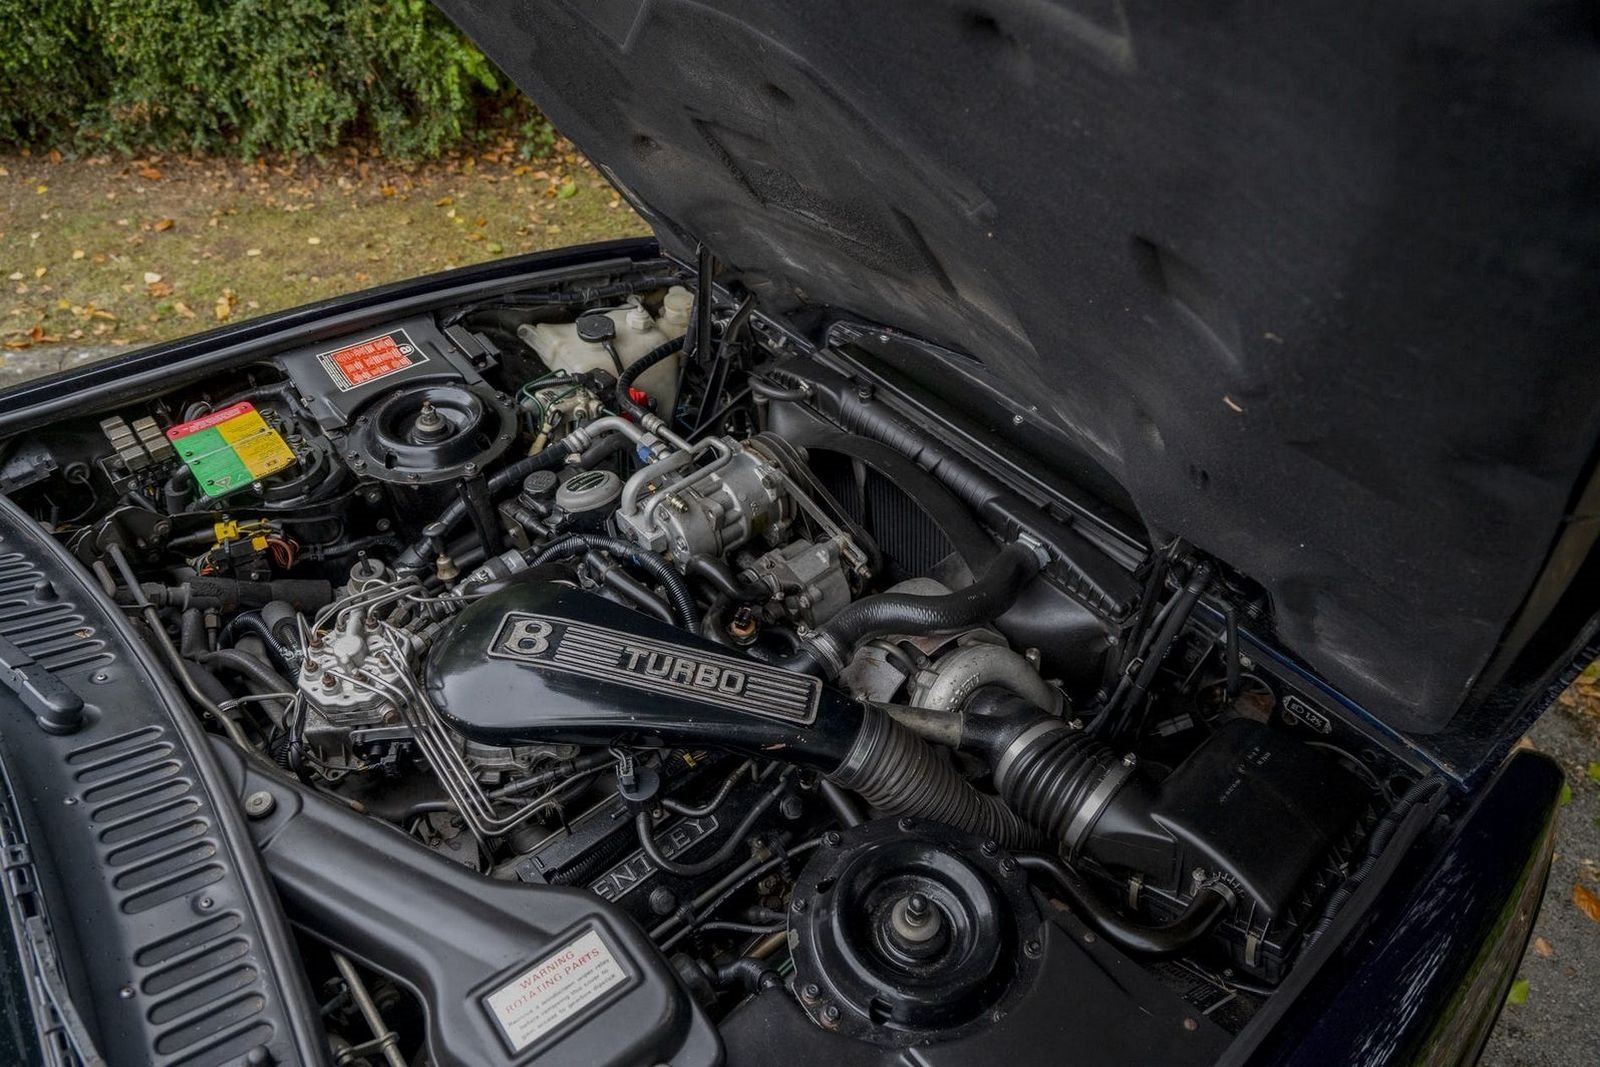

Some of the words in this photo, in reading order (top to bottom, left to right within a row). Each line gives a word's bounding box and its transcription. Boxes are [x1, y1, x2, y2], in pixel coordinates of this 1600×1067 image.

[504, 620, 554, 656] B
[624, 646, 746, 694] TURBO
[592, 818, 704, 900] ENTEY
[506, 973, 562, 1013] ROTATING
[564, 948, 600, 974] PARTS
[520, 950, 574, 988] WARNING
